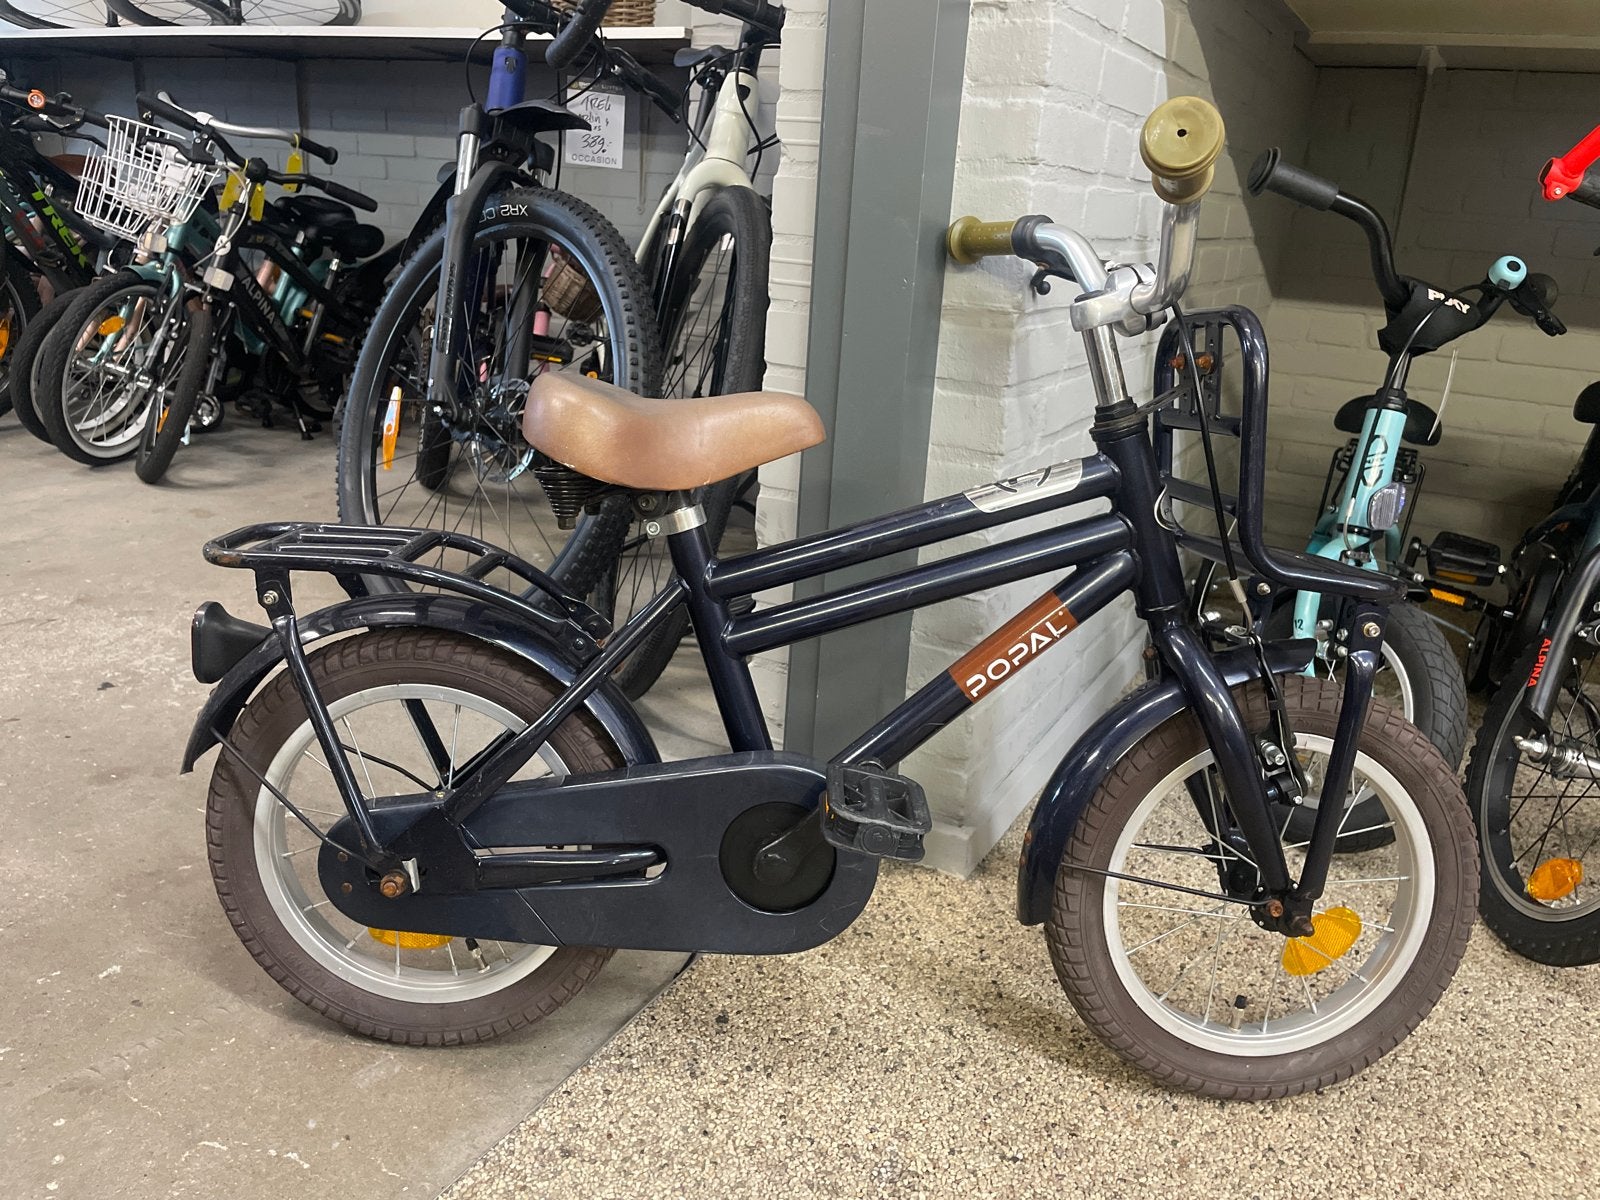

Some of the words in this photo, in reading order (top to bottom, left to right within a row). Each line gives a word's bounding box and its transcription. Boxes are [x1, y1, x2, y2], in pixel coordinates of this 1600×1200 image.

[571, 153, 617, 165] OCCASION
[31, 190, 87, 268] TREK
[500, 204, 528, 217] XR2
[241, 276, 276, 324] ALPINA
[1294, 618, 1304, 631] 12
[965, 621, 1068, 698] POPAL
[1527, 638, 1552, 687] ALPINA
